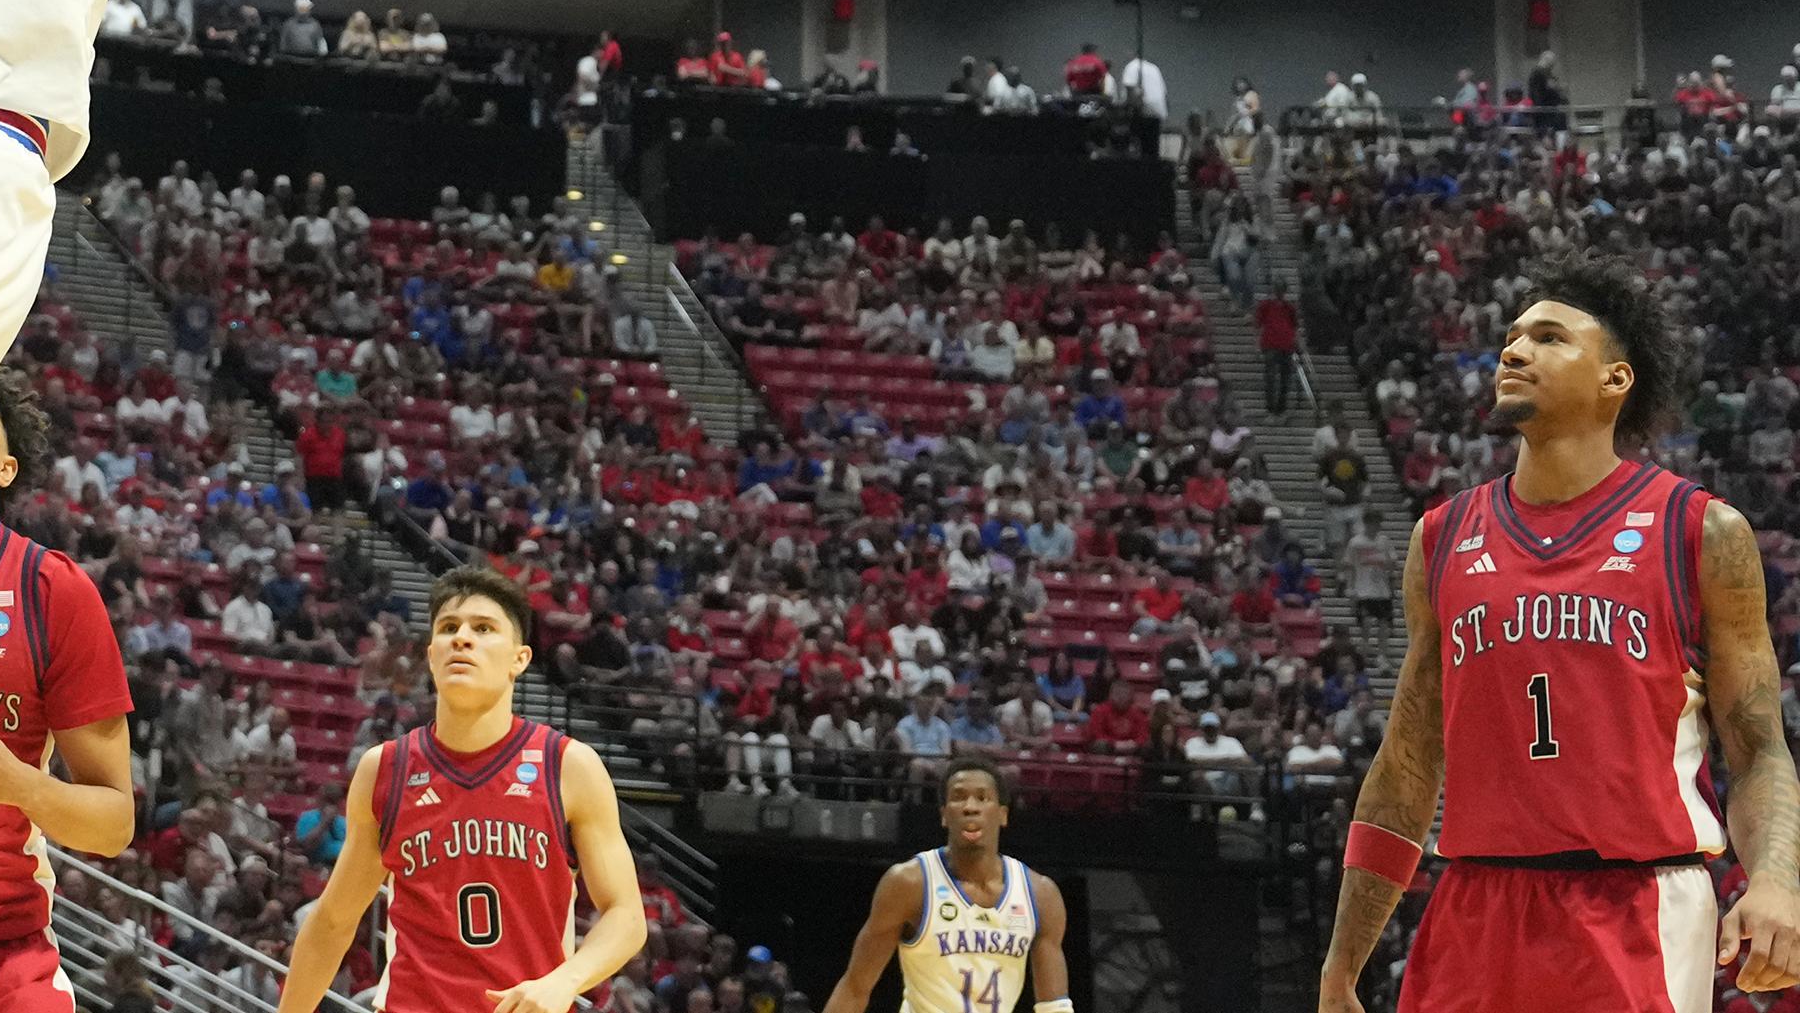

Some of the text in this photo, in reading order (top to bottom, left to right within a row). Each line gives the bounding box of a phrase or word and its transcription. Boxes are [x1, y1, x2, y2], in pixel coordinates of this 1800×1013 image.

[1451, 603, 1494, 667] ST.
[1502, 593, 1648, 660] JOHN'S
[1527, 673, 1559, 760] 1
[400, 818, 549, 877] ST. JOHN'S
[457, 882, 503, 948] 0
[936, 929, 1029, 959] KANSAS
[958, 967, 1004, 1013] 14
